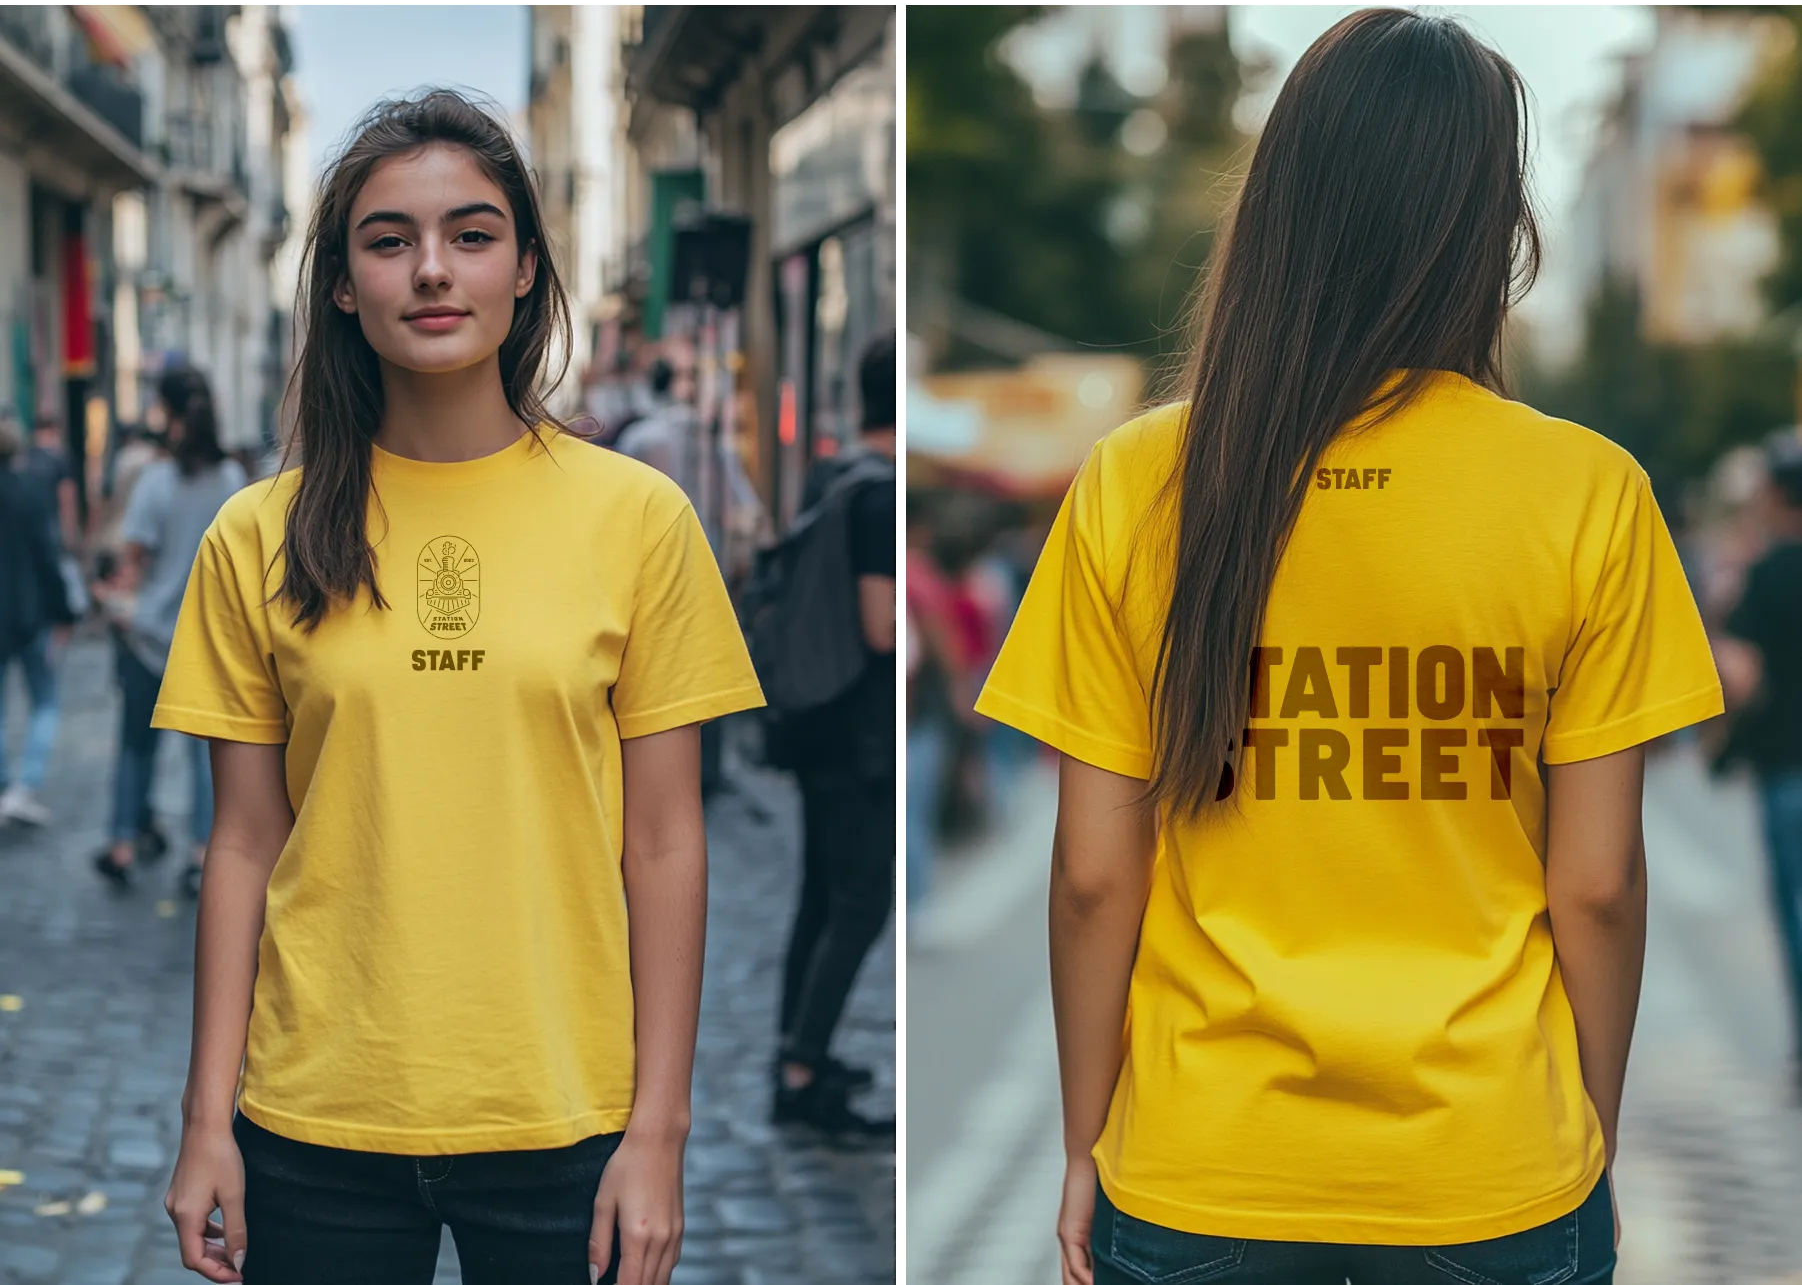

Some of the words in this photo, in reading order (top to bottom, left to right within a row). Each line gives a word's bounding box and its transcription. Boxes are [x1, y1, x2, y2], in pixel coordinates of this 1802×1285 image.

[1316, 468, 1391, 490] STAFF
[430, 623, 467, 631] STREET
[412, 650, 485, 671] STAFF
[1249, 645, 1524, 720] TATION
[1215, 728, 1524, 802] TREET
